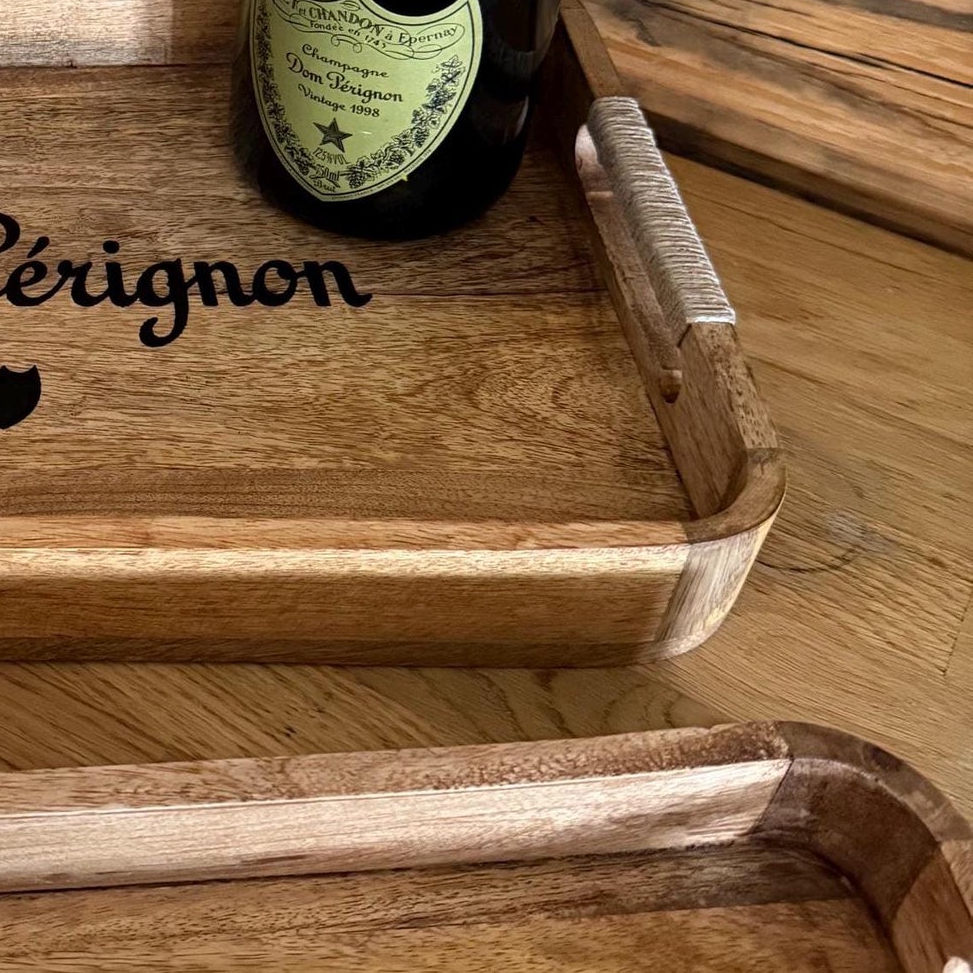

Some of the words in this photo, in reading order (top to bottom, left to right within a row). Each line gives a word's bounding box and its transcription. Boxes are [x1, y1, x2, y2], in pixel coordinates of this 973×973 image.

[309, 6, 385, 37] CHANDON
[348, 27, 360, 37] en
[286, 52, 324, 85] Dom
[326, 71, 404, 104] Pérignon
[302, 43, 388, 78] Champagne
[298, 83, 346, 112] Vintage
[351, 103, 380, 118] 1998
